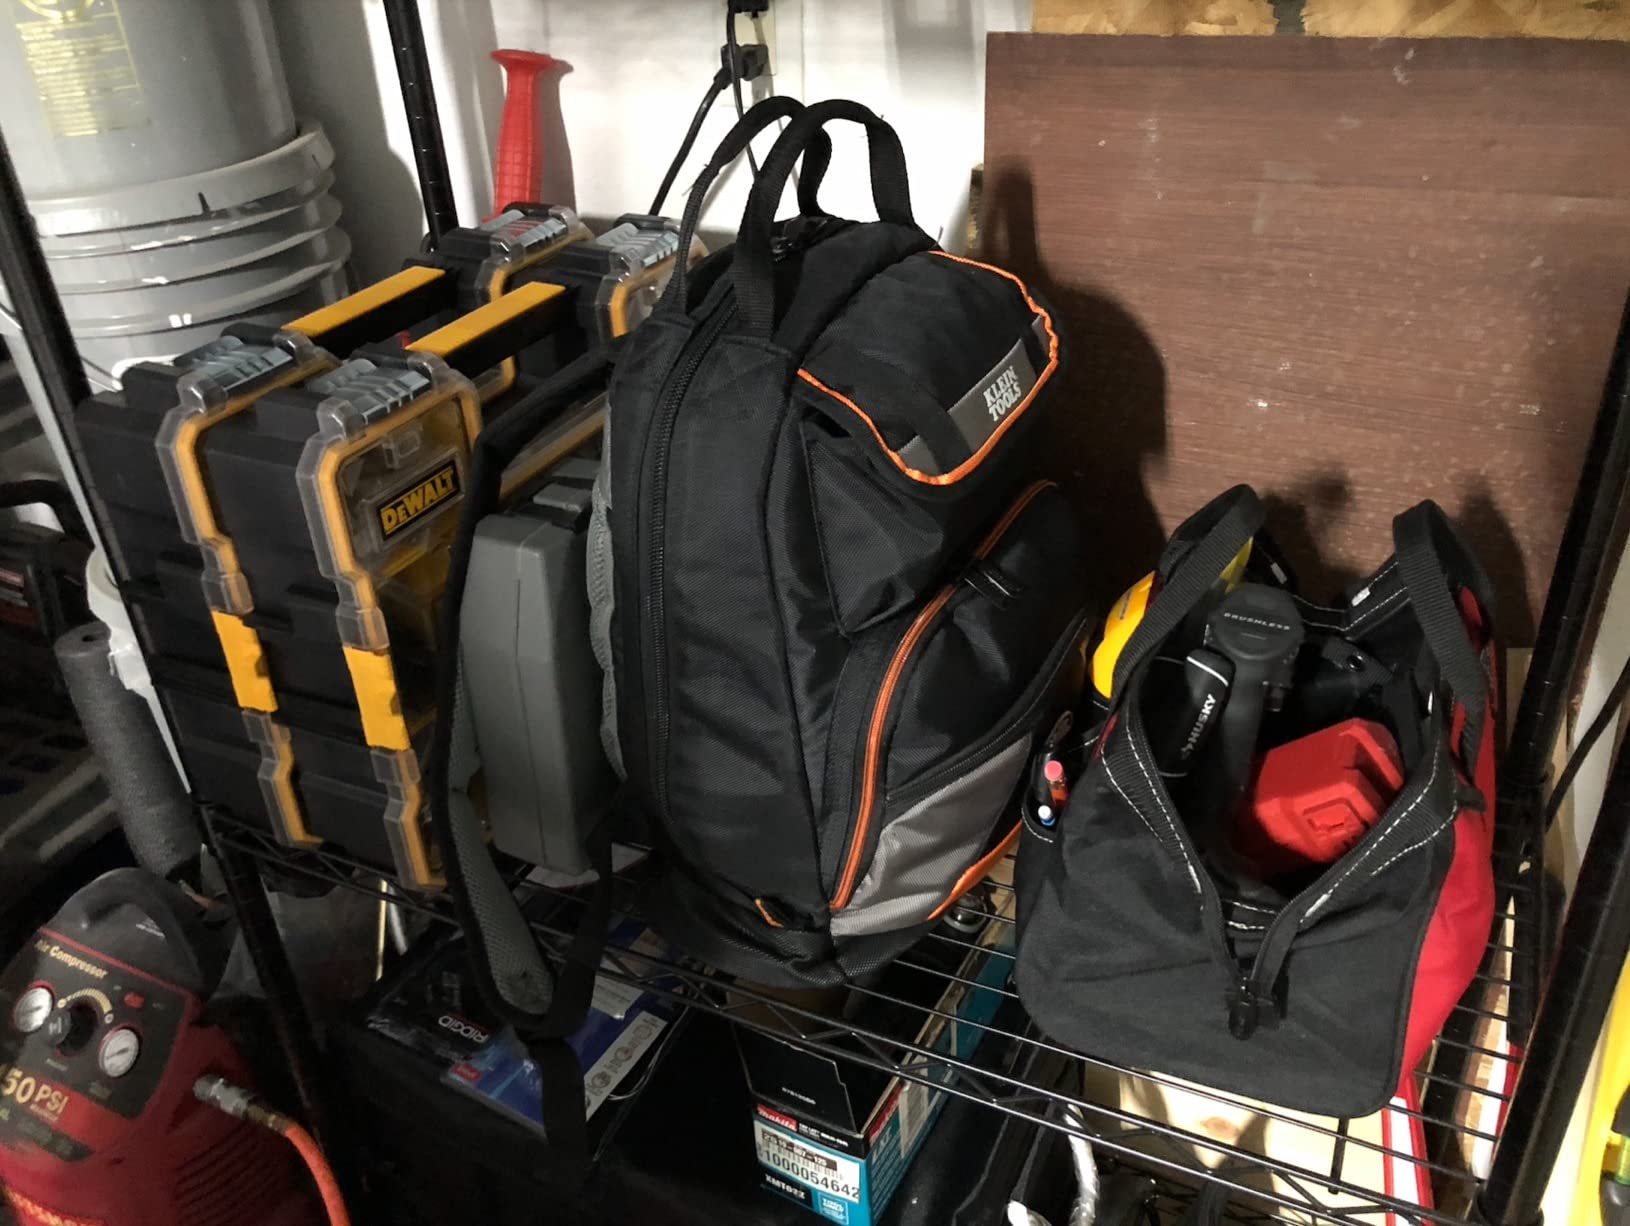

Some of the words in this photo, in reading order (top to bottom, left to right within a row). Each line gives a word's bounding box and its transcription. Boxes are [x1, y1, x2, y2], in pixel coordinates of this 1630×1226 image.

[983, 366, 1018, 408] KLEIN
[989, 382, 1021, 422] TOOLS
[1223, 611, 1291, 631] BRUSHLESS
[1187, 693, 1217, 745] HUSKY
[49, 945, 109, 980] Compressor
[438, 1015, 489, 1044] RIDGID
[34, 1084, 70, 1115] PSI
[764, 1149, 860, 1200] 1000054642
